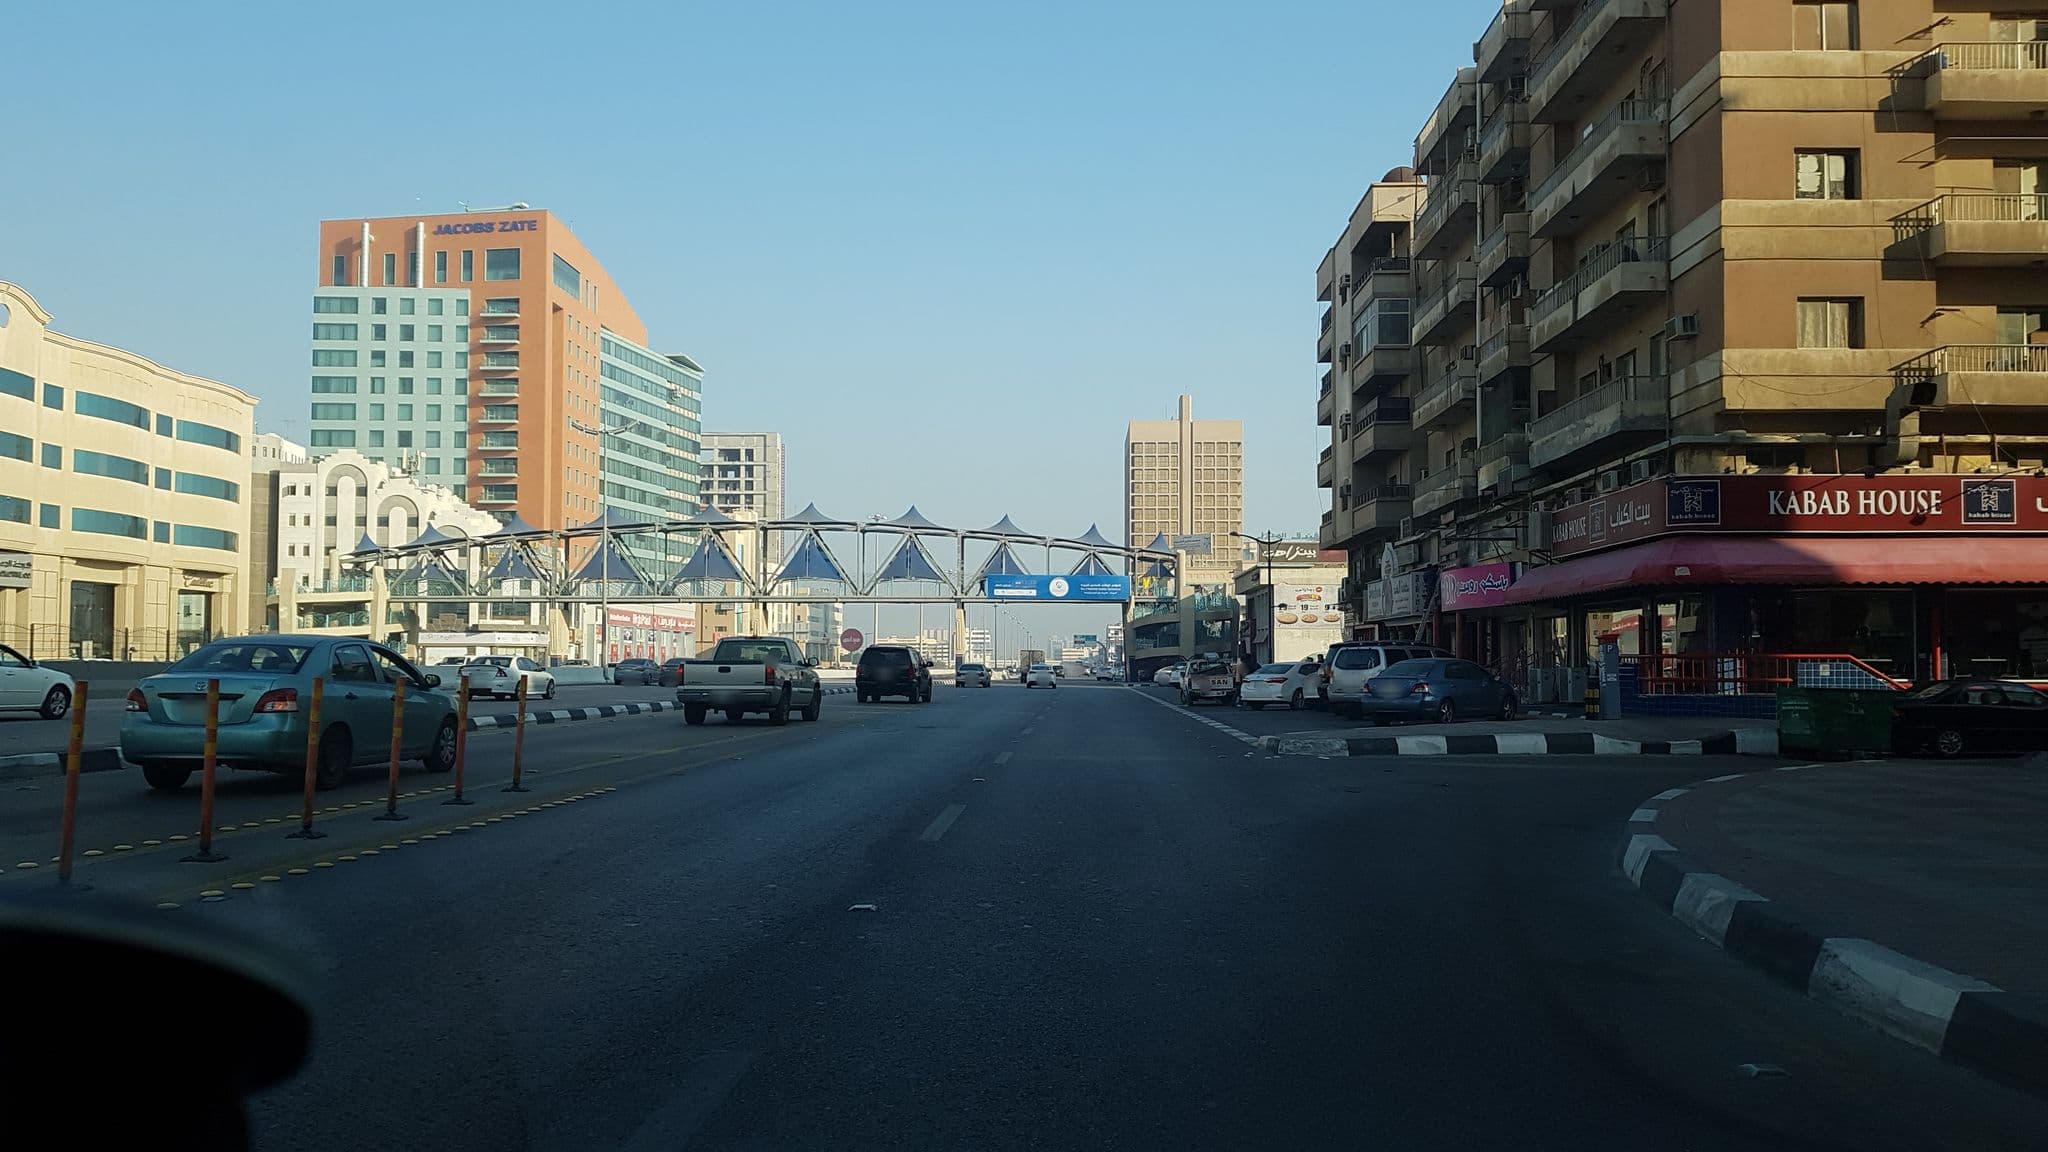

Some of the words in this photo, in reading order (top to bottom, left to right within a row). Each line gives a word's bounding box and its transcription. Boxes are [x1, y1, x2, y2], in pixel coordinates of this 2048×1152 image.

[433, 222, 496, 235] JACOBS
[499, 220, 538, 233] ZATE
[1634, 503, 1651, 526] بيت
[1768, 490, 1851, 516] KABAB
[1857, 489, 1943, 516] HOUSE
[1568, 515, 1587, 541] HOUSE
[1609, 500, 1635, 534] الكباب
[1607, 644, 1613, 653] P
